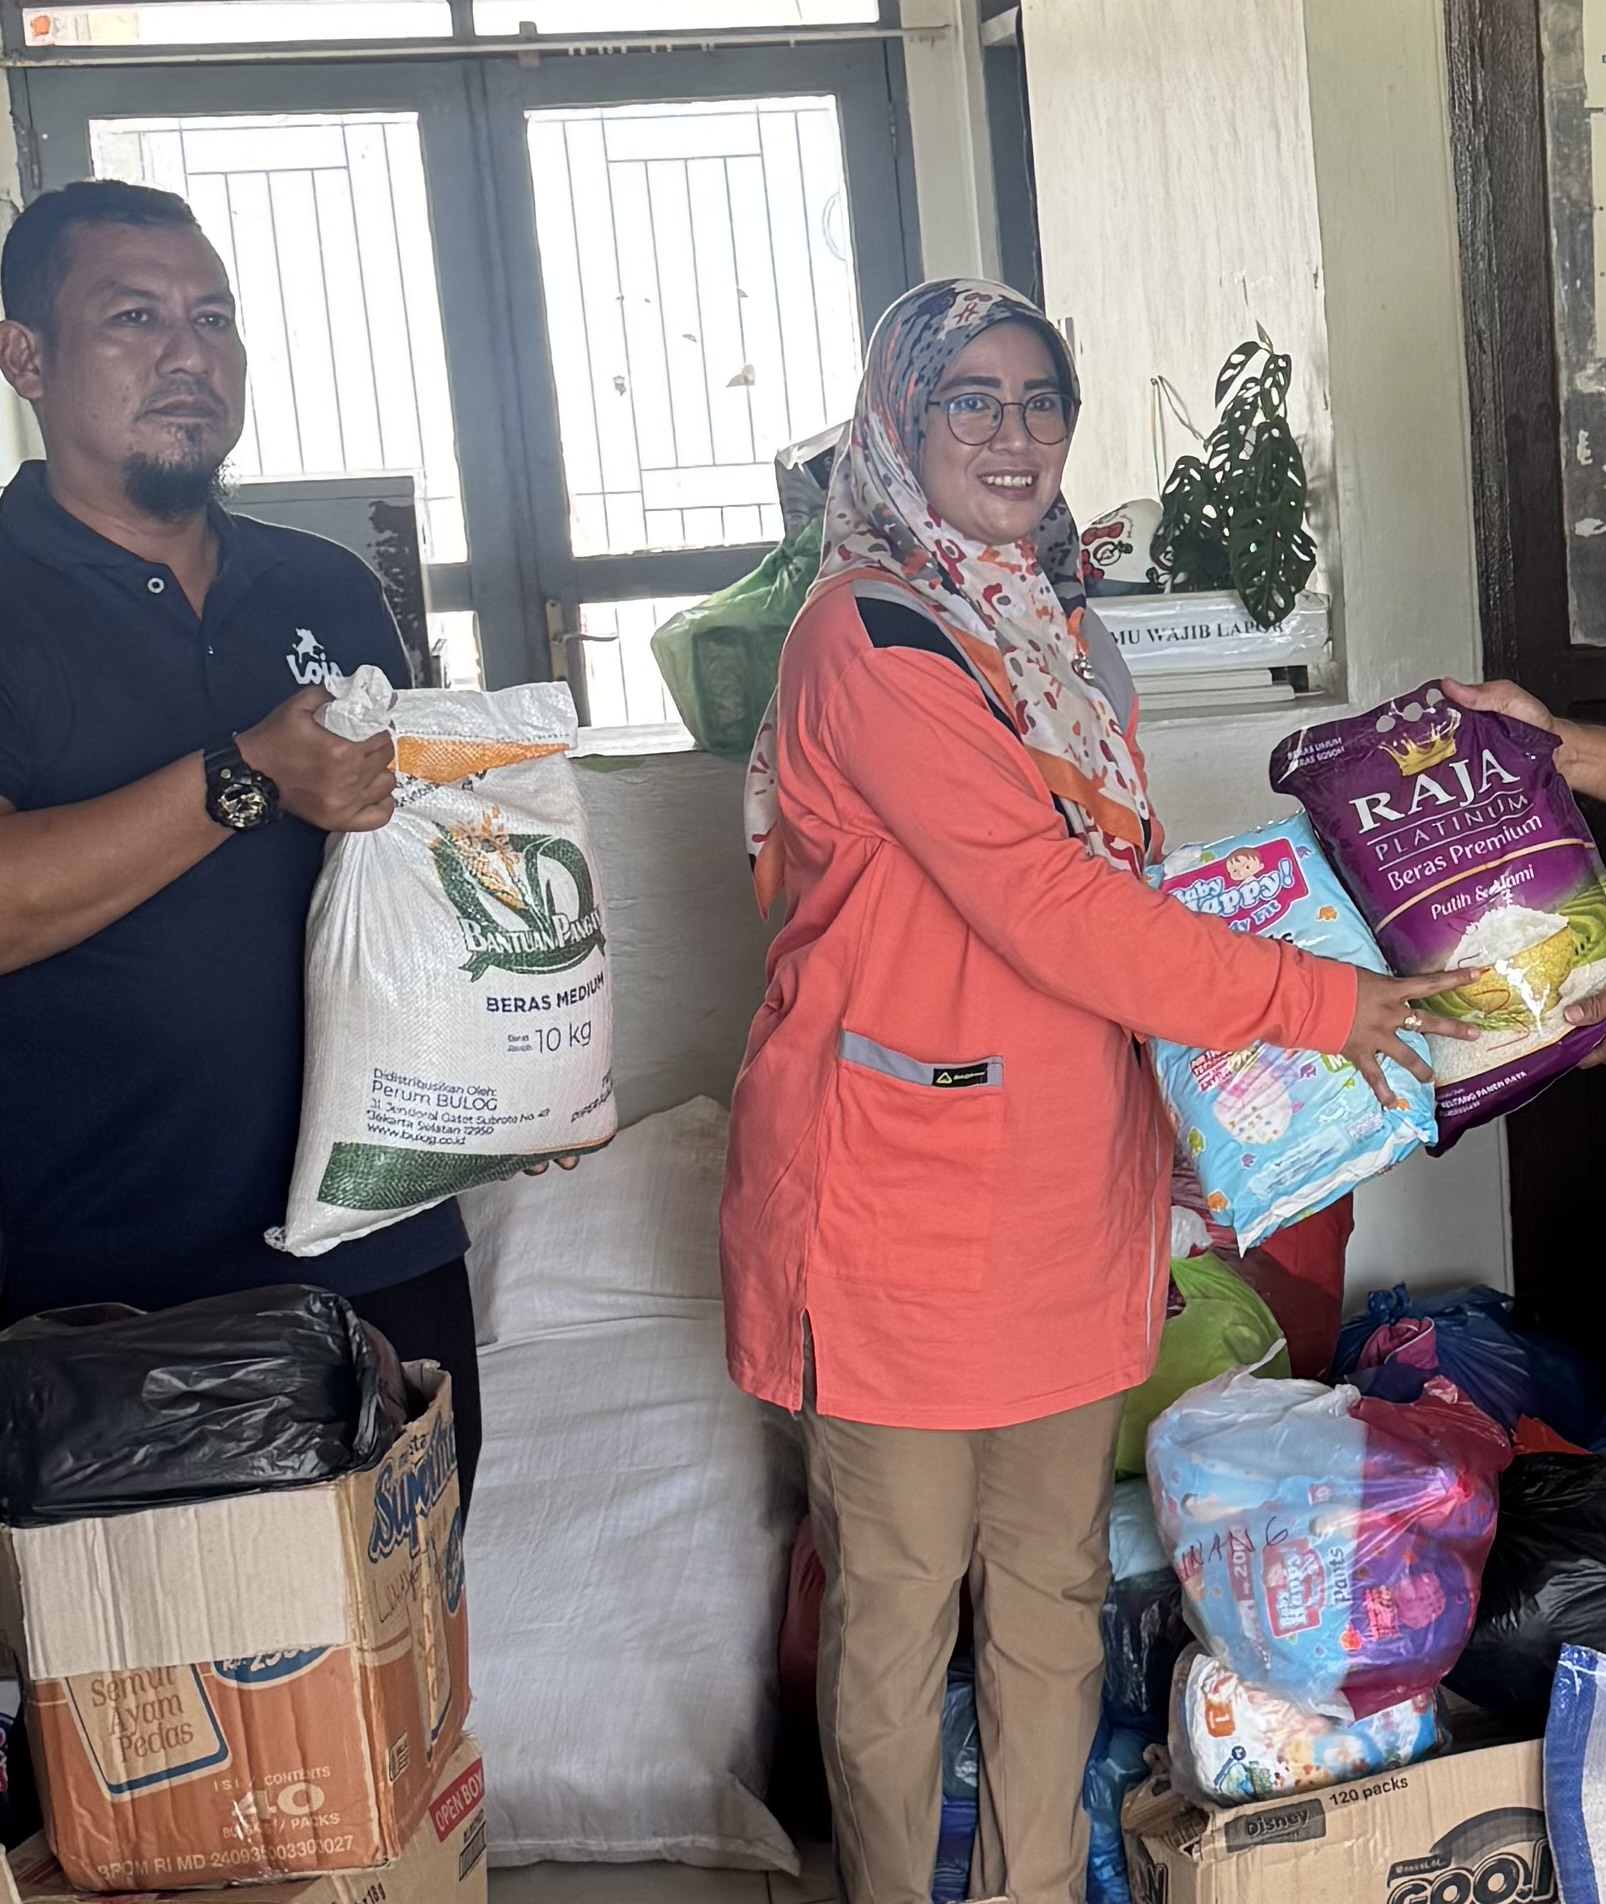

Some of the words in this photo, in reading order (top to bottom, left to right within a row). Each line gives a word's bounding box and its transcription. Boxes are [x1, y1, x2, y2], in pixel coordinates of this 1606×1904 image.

[1147, 624, 1212, 643] WAJIB
[1350, 749, 1521, 834] RAJA
[1374, 794, 1529, 861] PLATINUM
[1388, 854, 1448, 892] Beras
[1450, 815, 1543, 865] Premium
[1431, 894, 1472, 921] Putih
[486, 995, 551, 1013] BERAS
[535, 1026, 562, 1055] 10
[569, 1020, 592, 1048] kg
[372, 1080, 432, 1106] Perum
[436, 1094, 498, 1112] BULOG
[108, 1695, 184, 1735] Ayam
[119, 1722, 194, 1763] Pedas
[435, 1786, 462, 1833] OPEN
[459, 1771, 484, 1806] BOX
[1329, 1787, 1360, 1806] 120
[1363, 1775, 1409, 1802] packs
[1247, 1810, 1311, 1839] Disney
[155, 1854, 172, 1873] RI
[177, 1853, 206, 1872] MD
